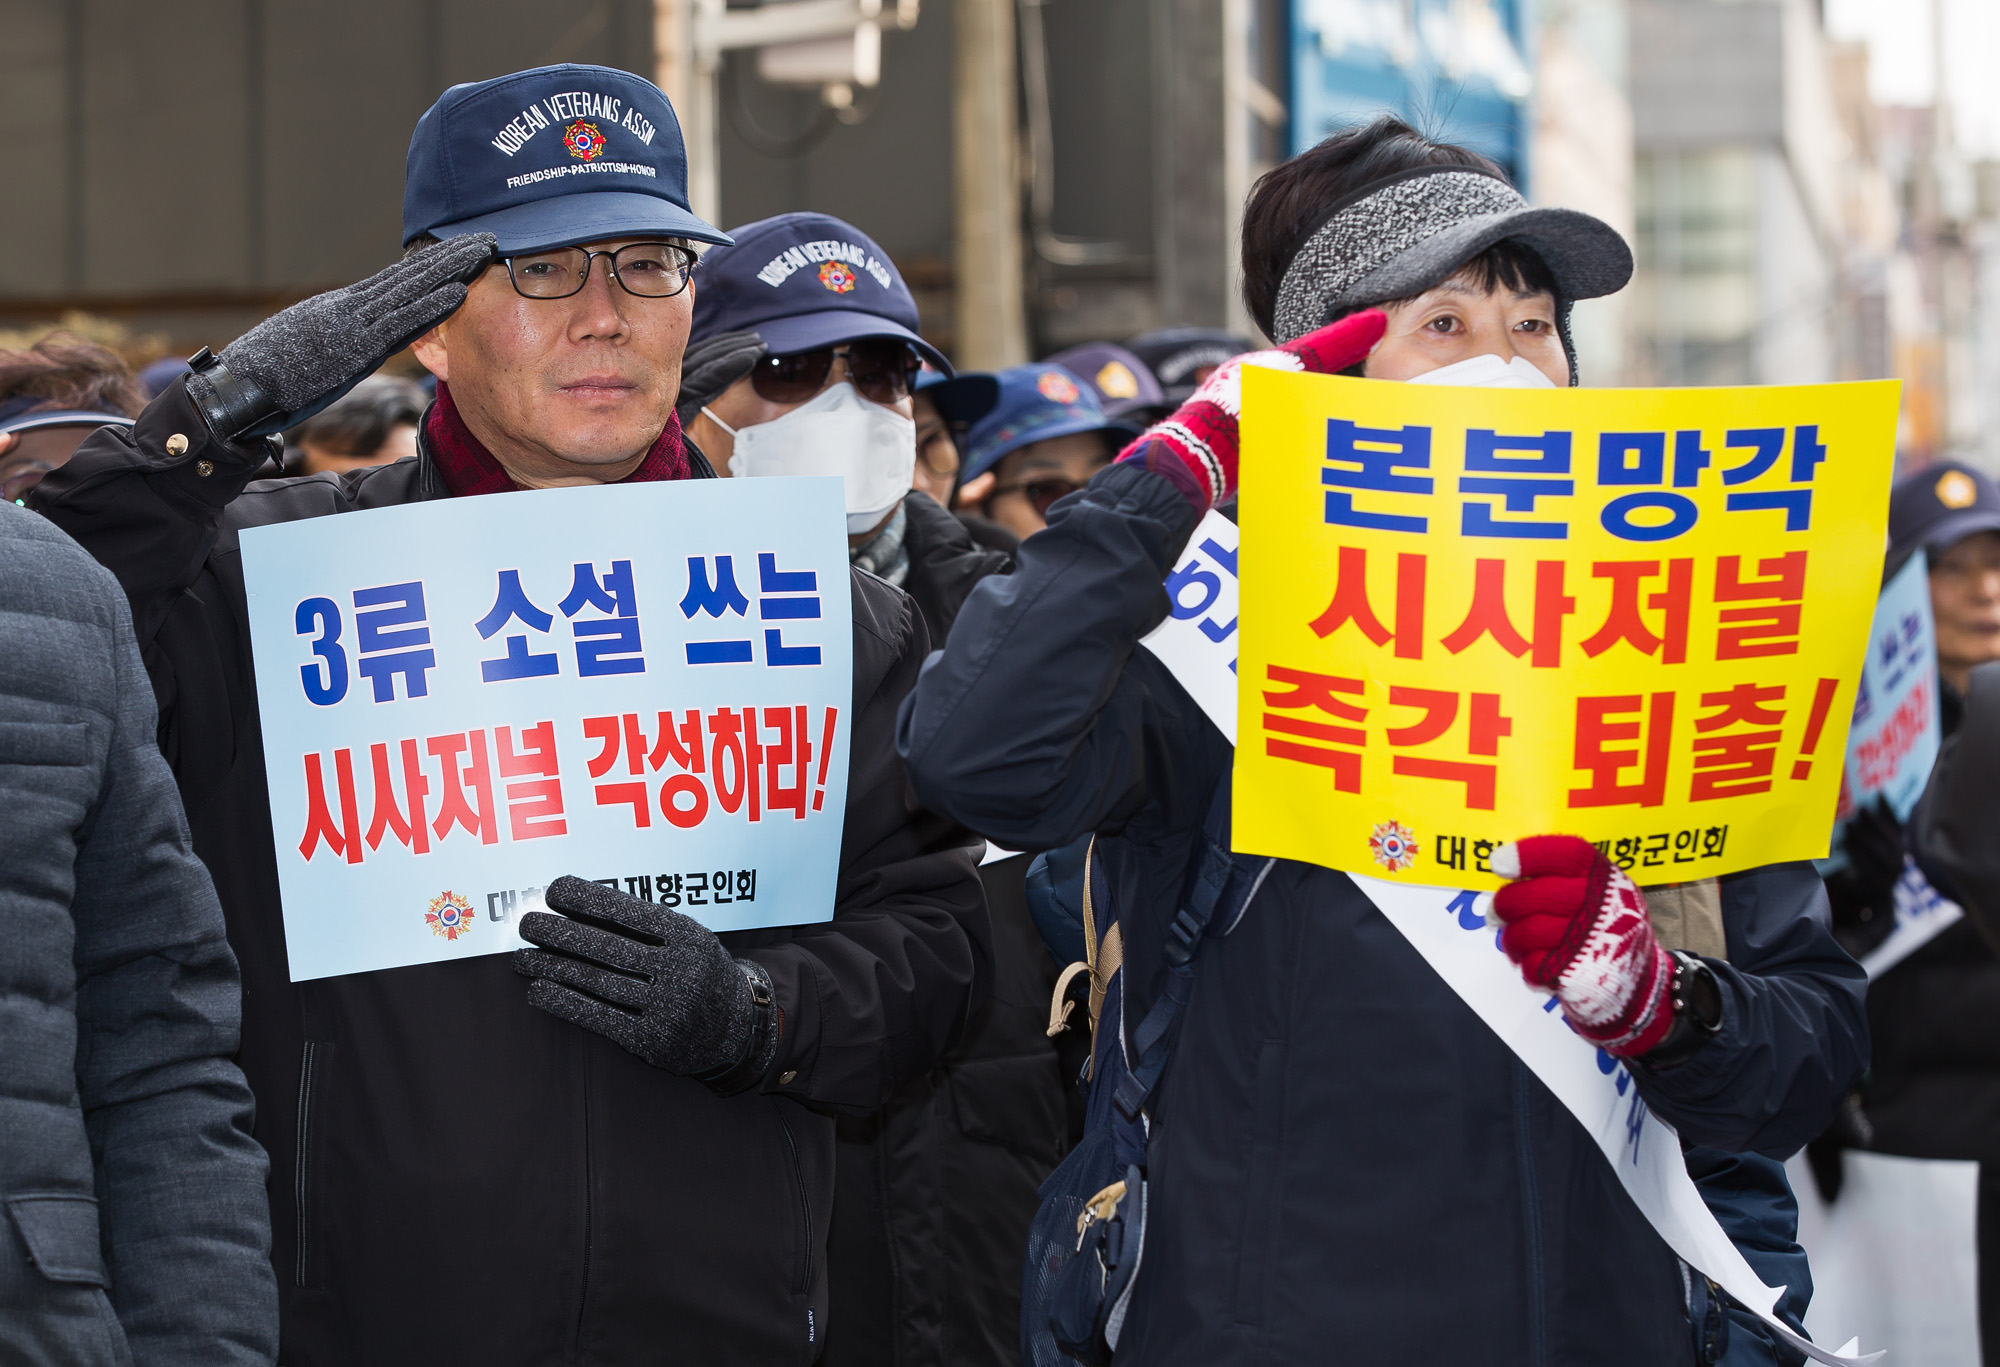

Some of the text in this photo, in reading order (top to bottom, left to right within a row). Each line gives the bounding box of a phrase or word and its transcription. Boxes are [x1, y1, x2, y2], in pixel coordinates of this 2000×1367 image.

[491, 91, 656, 157] KOREAN VETERANS ASSN
[756, 240, 892, 290] KOREAN VETERANS ASSN
[1322, 418, 1826, 542] 본분망각
[295, 552, 822, 706] 3류 소설 쓰는
[1308, 546, 1808, 668] 시사저널
[298, 705, 838, 865] 시사저널 각성하라!
[1262, 664, 1511, 811] 즉각
[1568, 677, 1839, 809] 퇴출!
